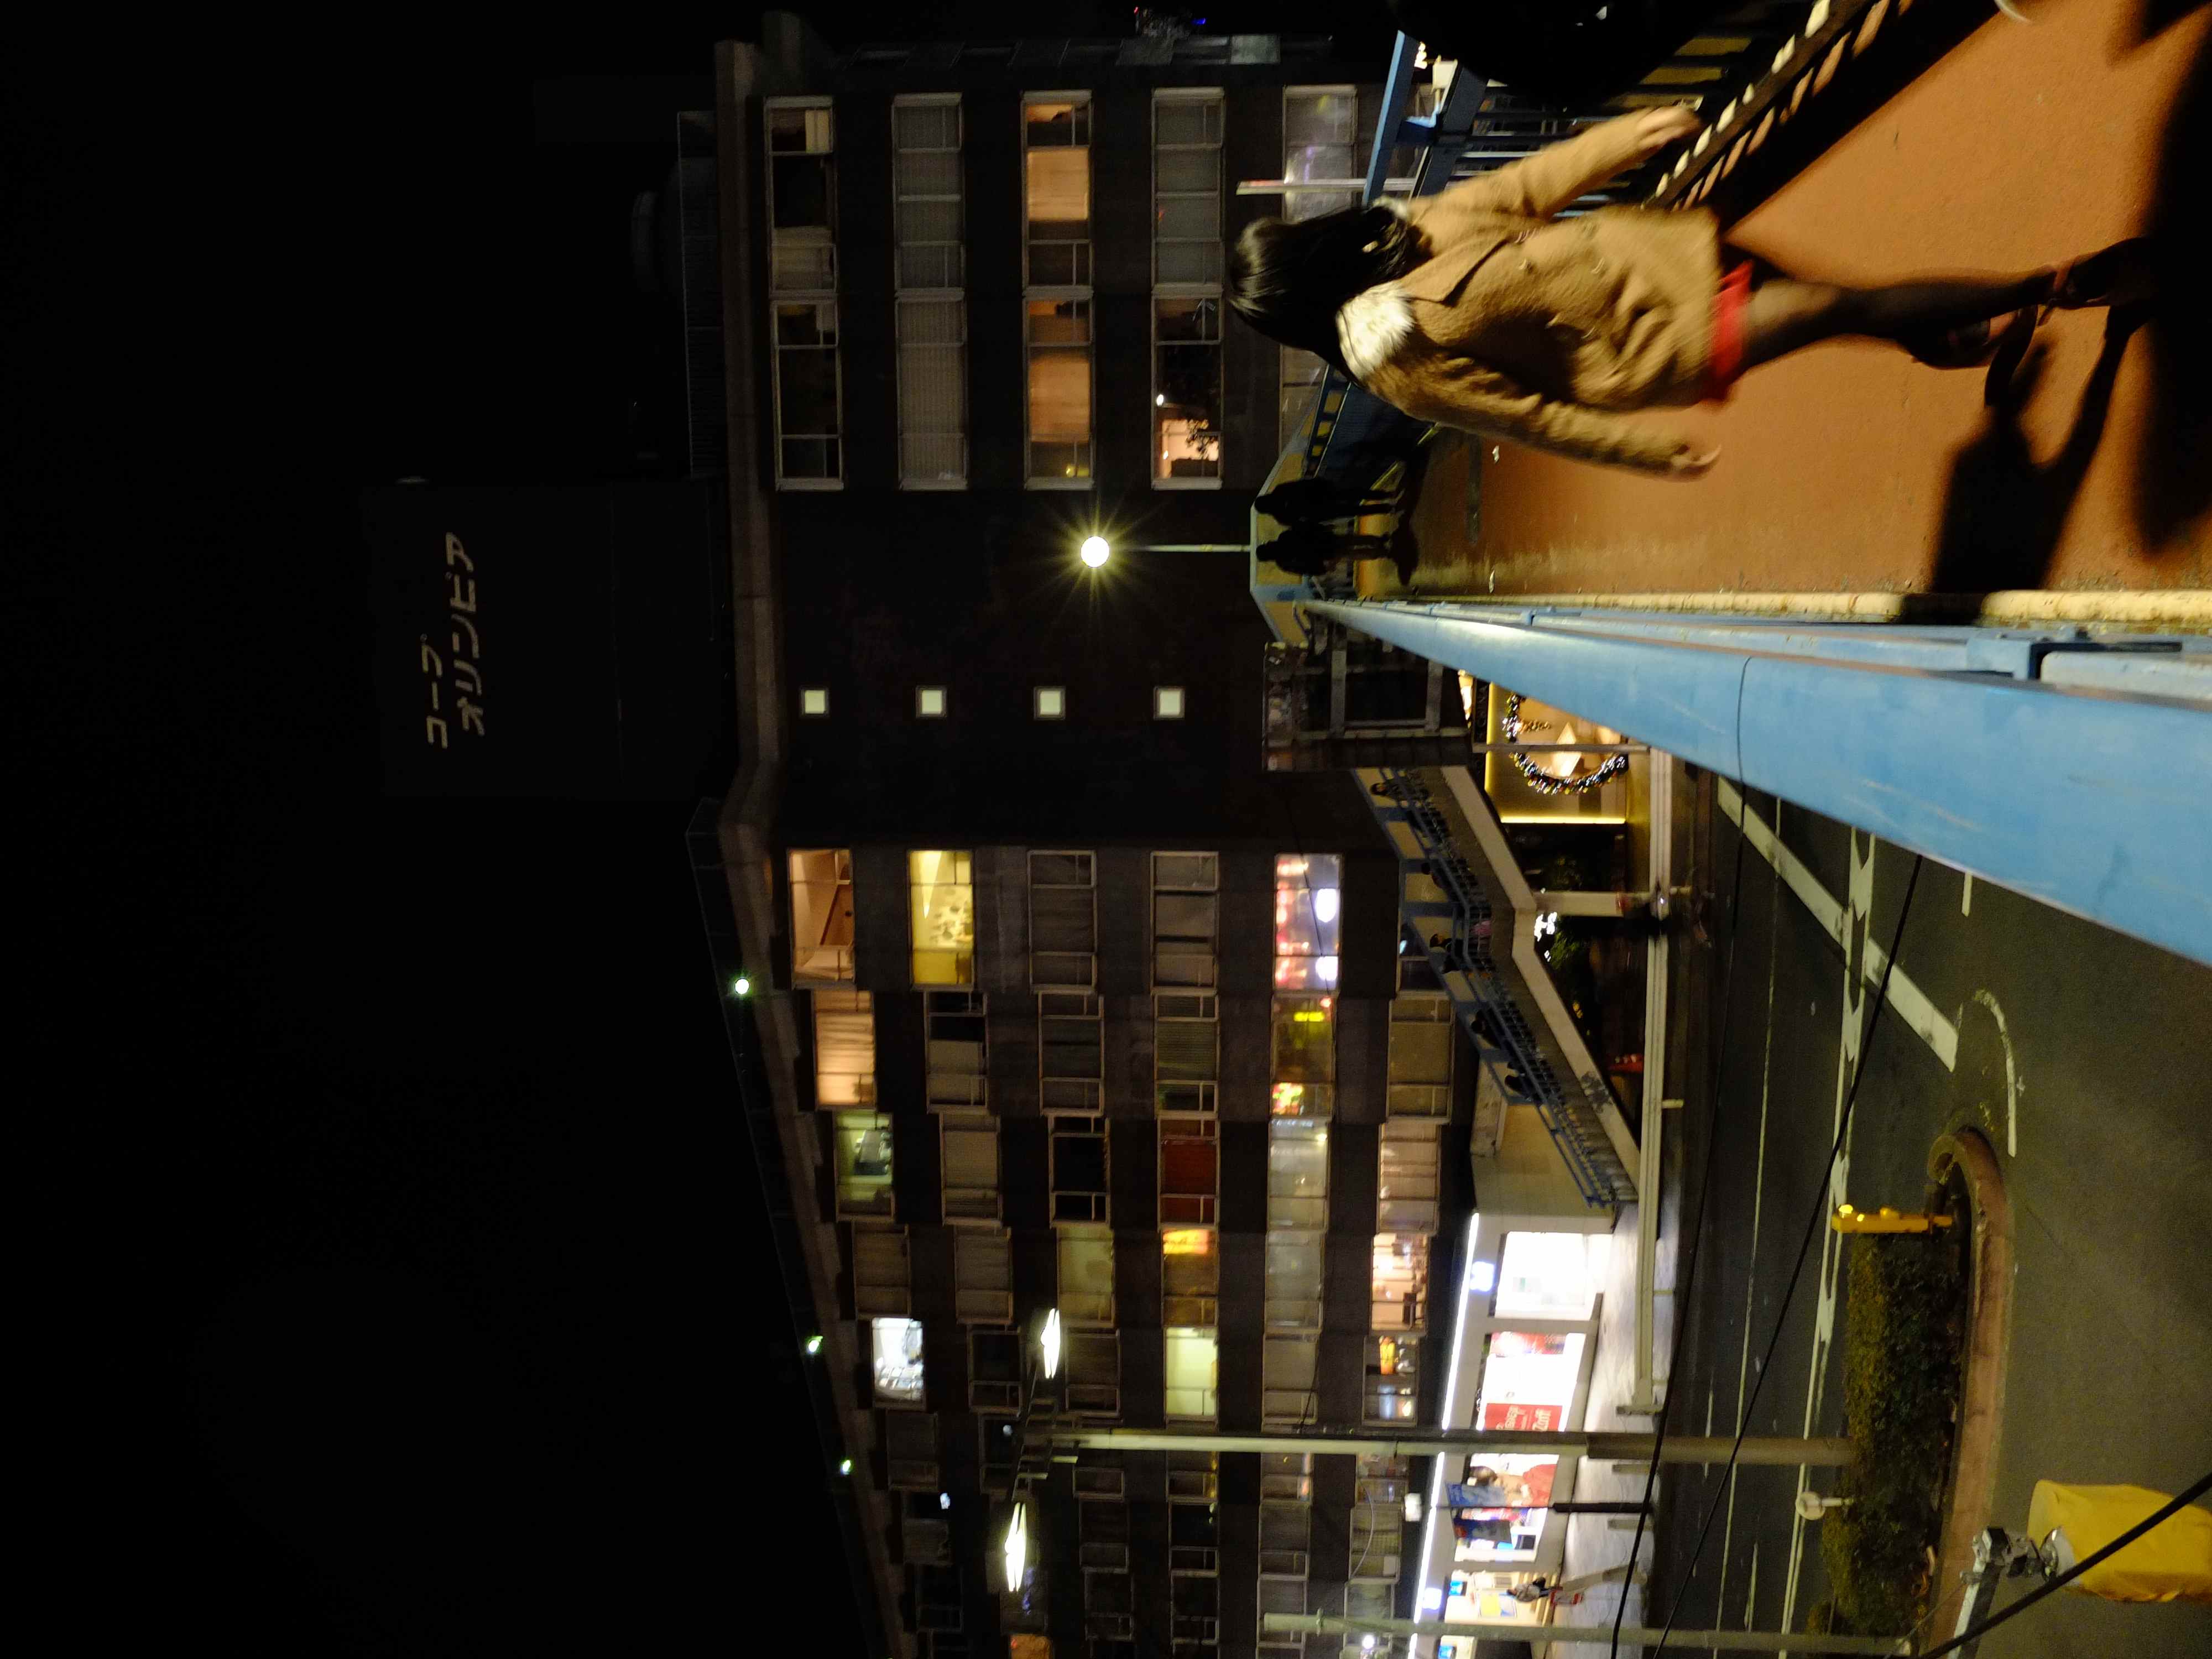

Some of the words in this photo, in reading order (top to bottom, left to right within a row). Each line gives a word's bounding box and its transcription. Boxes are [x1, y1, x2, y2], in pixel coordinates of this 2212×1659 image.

[420, 632, 449, 749] コープ
[444, 531, 486, 737] オリンピア
